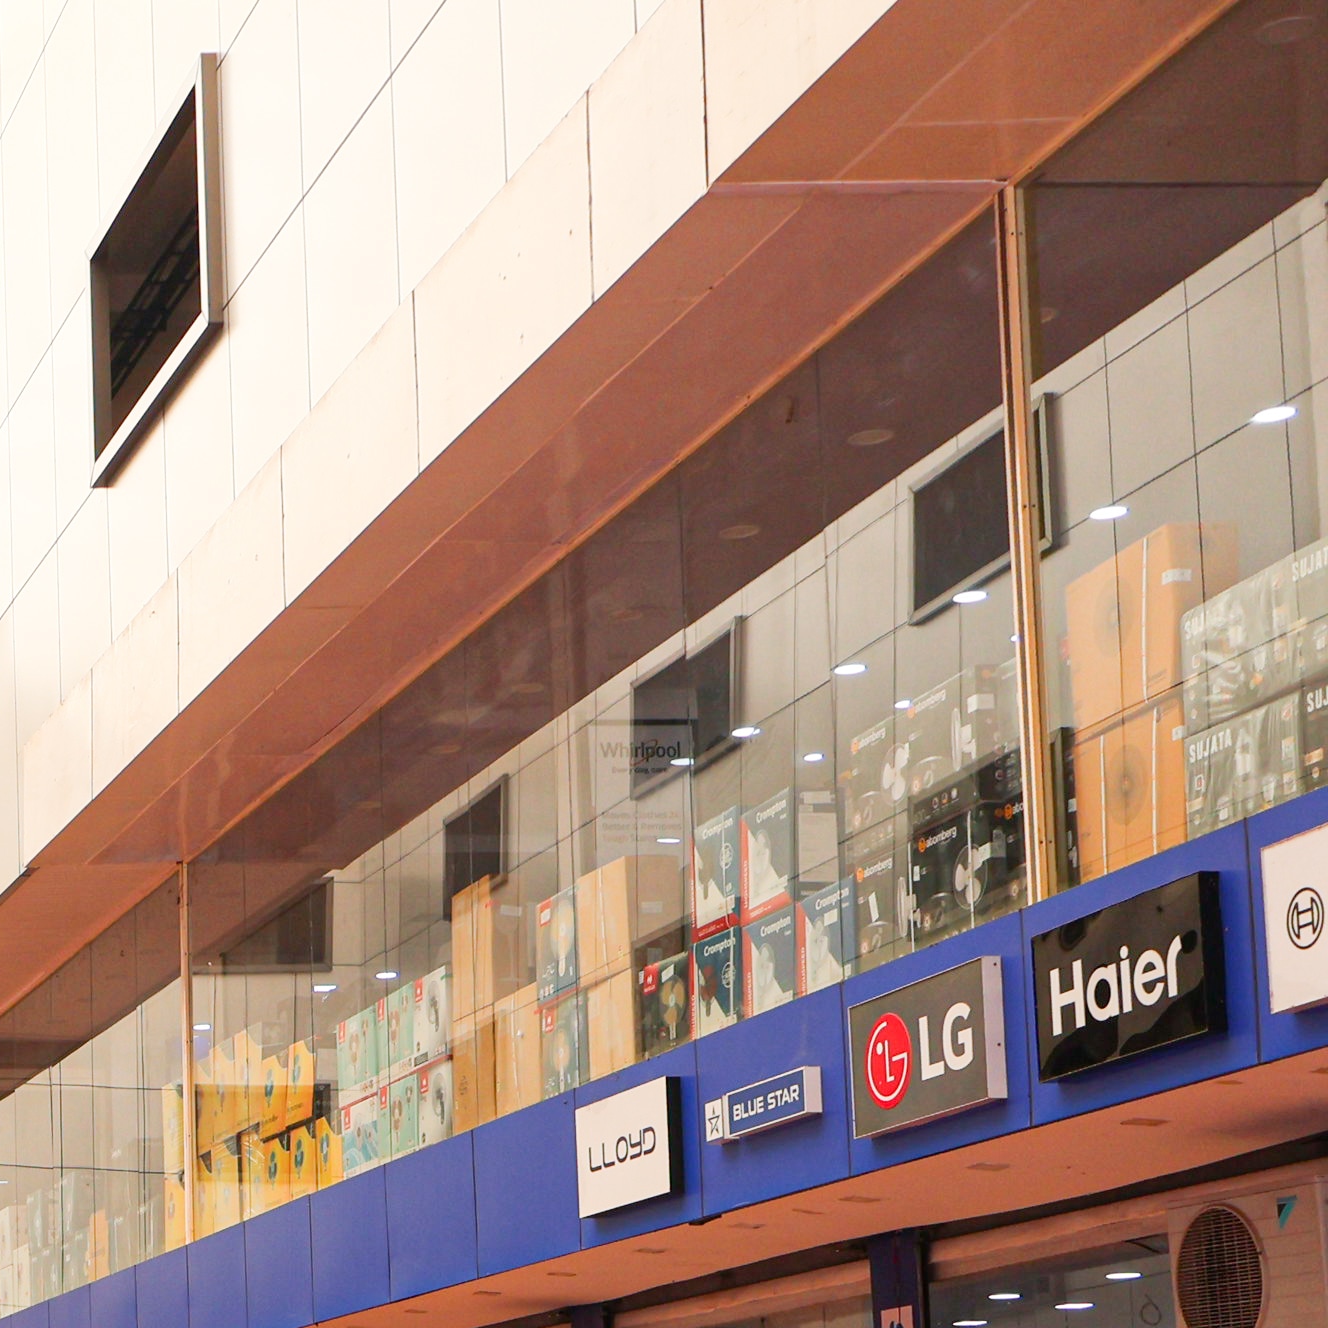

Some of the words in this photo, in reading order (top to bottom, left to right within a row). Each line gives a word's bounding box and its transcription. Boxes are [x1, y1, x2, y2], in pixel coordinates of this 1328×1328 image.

[600, 741, 681, 763] Whirlpool
[1189, 729, 1232, 763] SUJATA
[926, 826, 957, 849] atomberg
[760, 916, 791, 937] Crompton
[1049, 934, 1182, 1038] Haier
[917, 1001, 974, 1083] LG
[732, 1097, 764, 1123] BLUE
[766, 1084, 800, 1111] STAR
[588, 1125, 658, 1173] LLOYD
